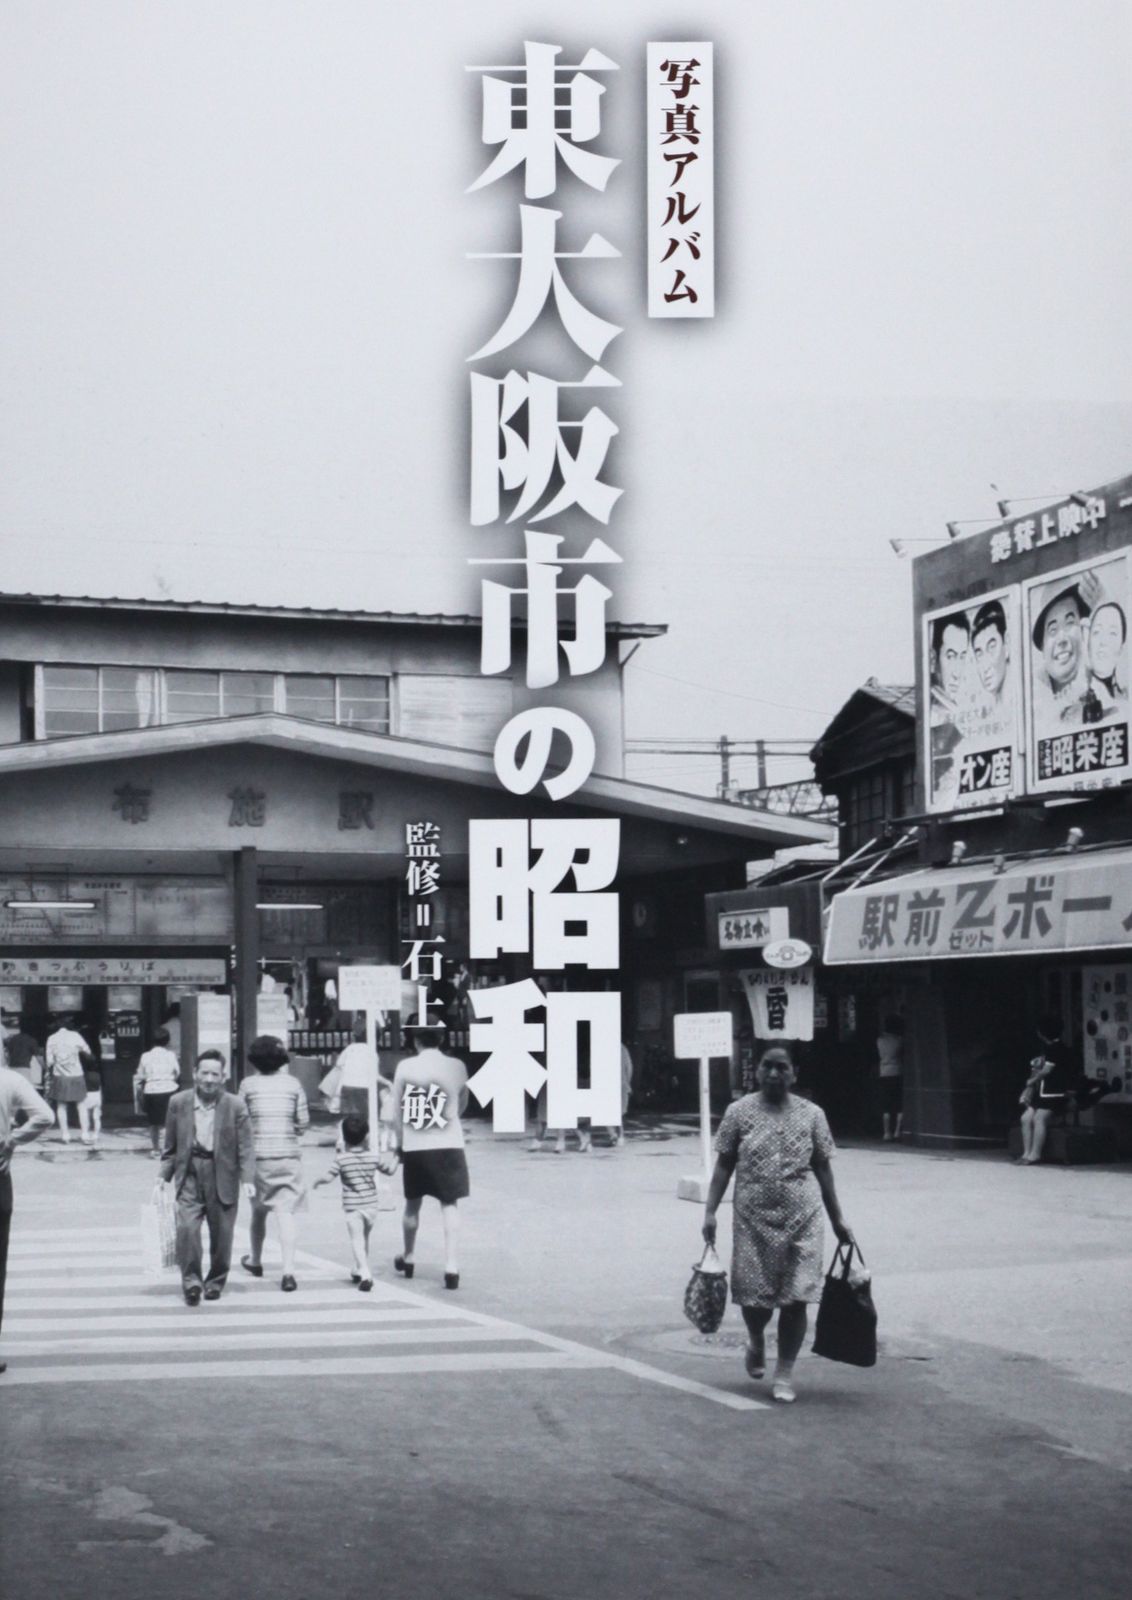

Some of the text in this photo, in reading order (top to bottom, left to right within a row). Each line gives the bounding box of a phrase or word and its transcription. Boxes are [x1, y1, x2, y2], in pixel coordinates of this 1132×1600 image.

[1051, 727, 1124, 775] 昭栄座
[949, 929, 993, 949] ゼット
